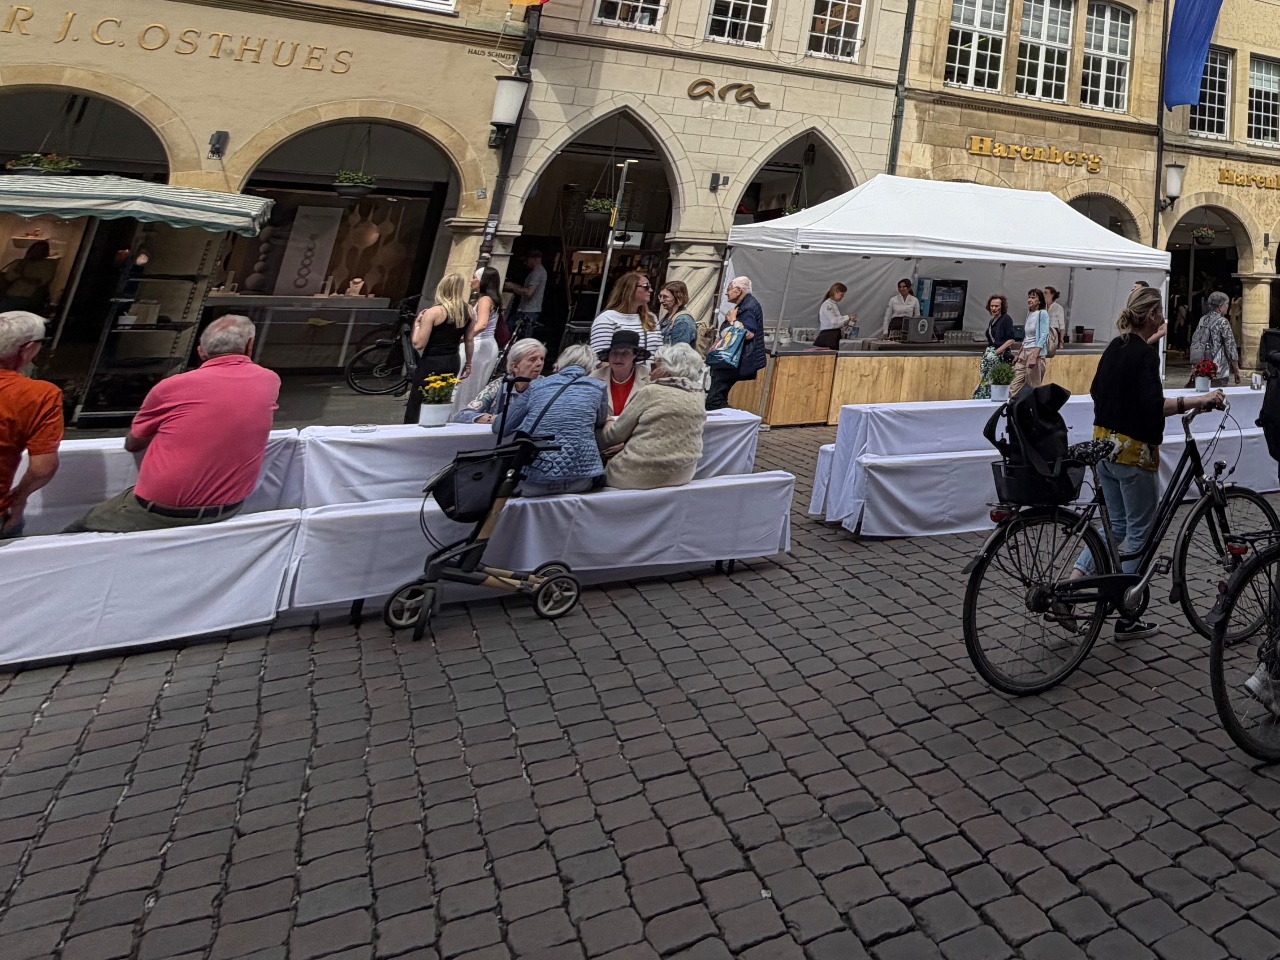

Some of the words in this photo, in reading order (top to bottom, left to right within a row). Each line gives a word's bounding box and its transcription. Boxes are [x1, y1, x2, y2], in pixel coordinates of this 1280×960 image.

[468, 48, 485, 56] HAUS
[487, 50, 516, 61] SCHMITT
[688, 78, 771, 109] ara
[969, 136, 1102, 173] Harenberg
